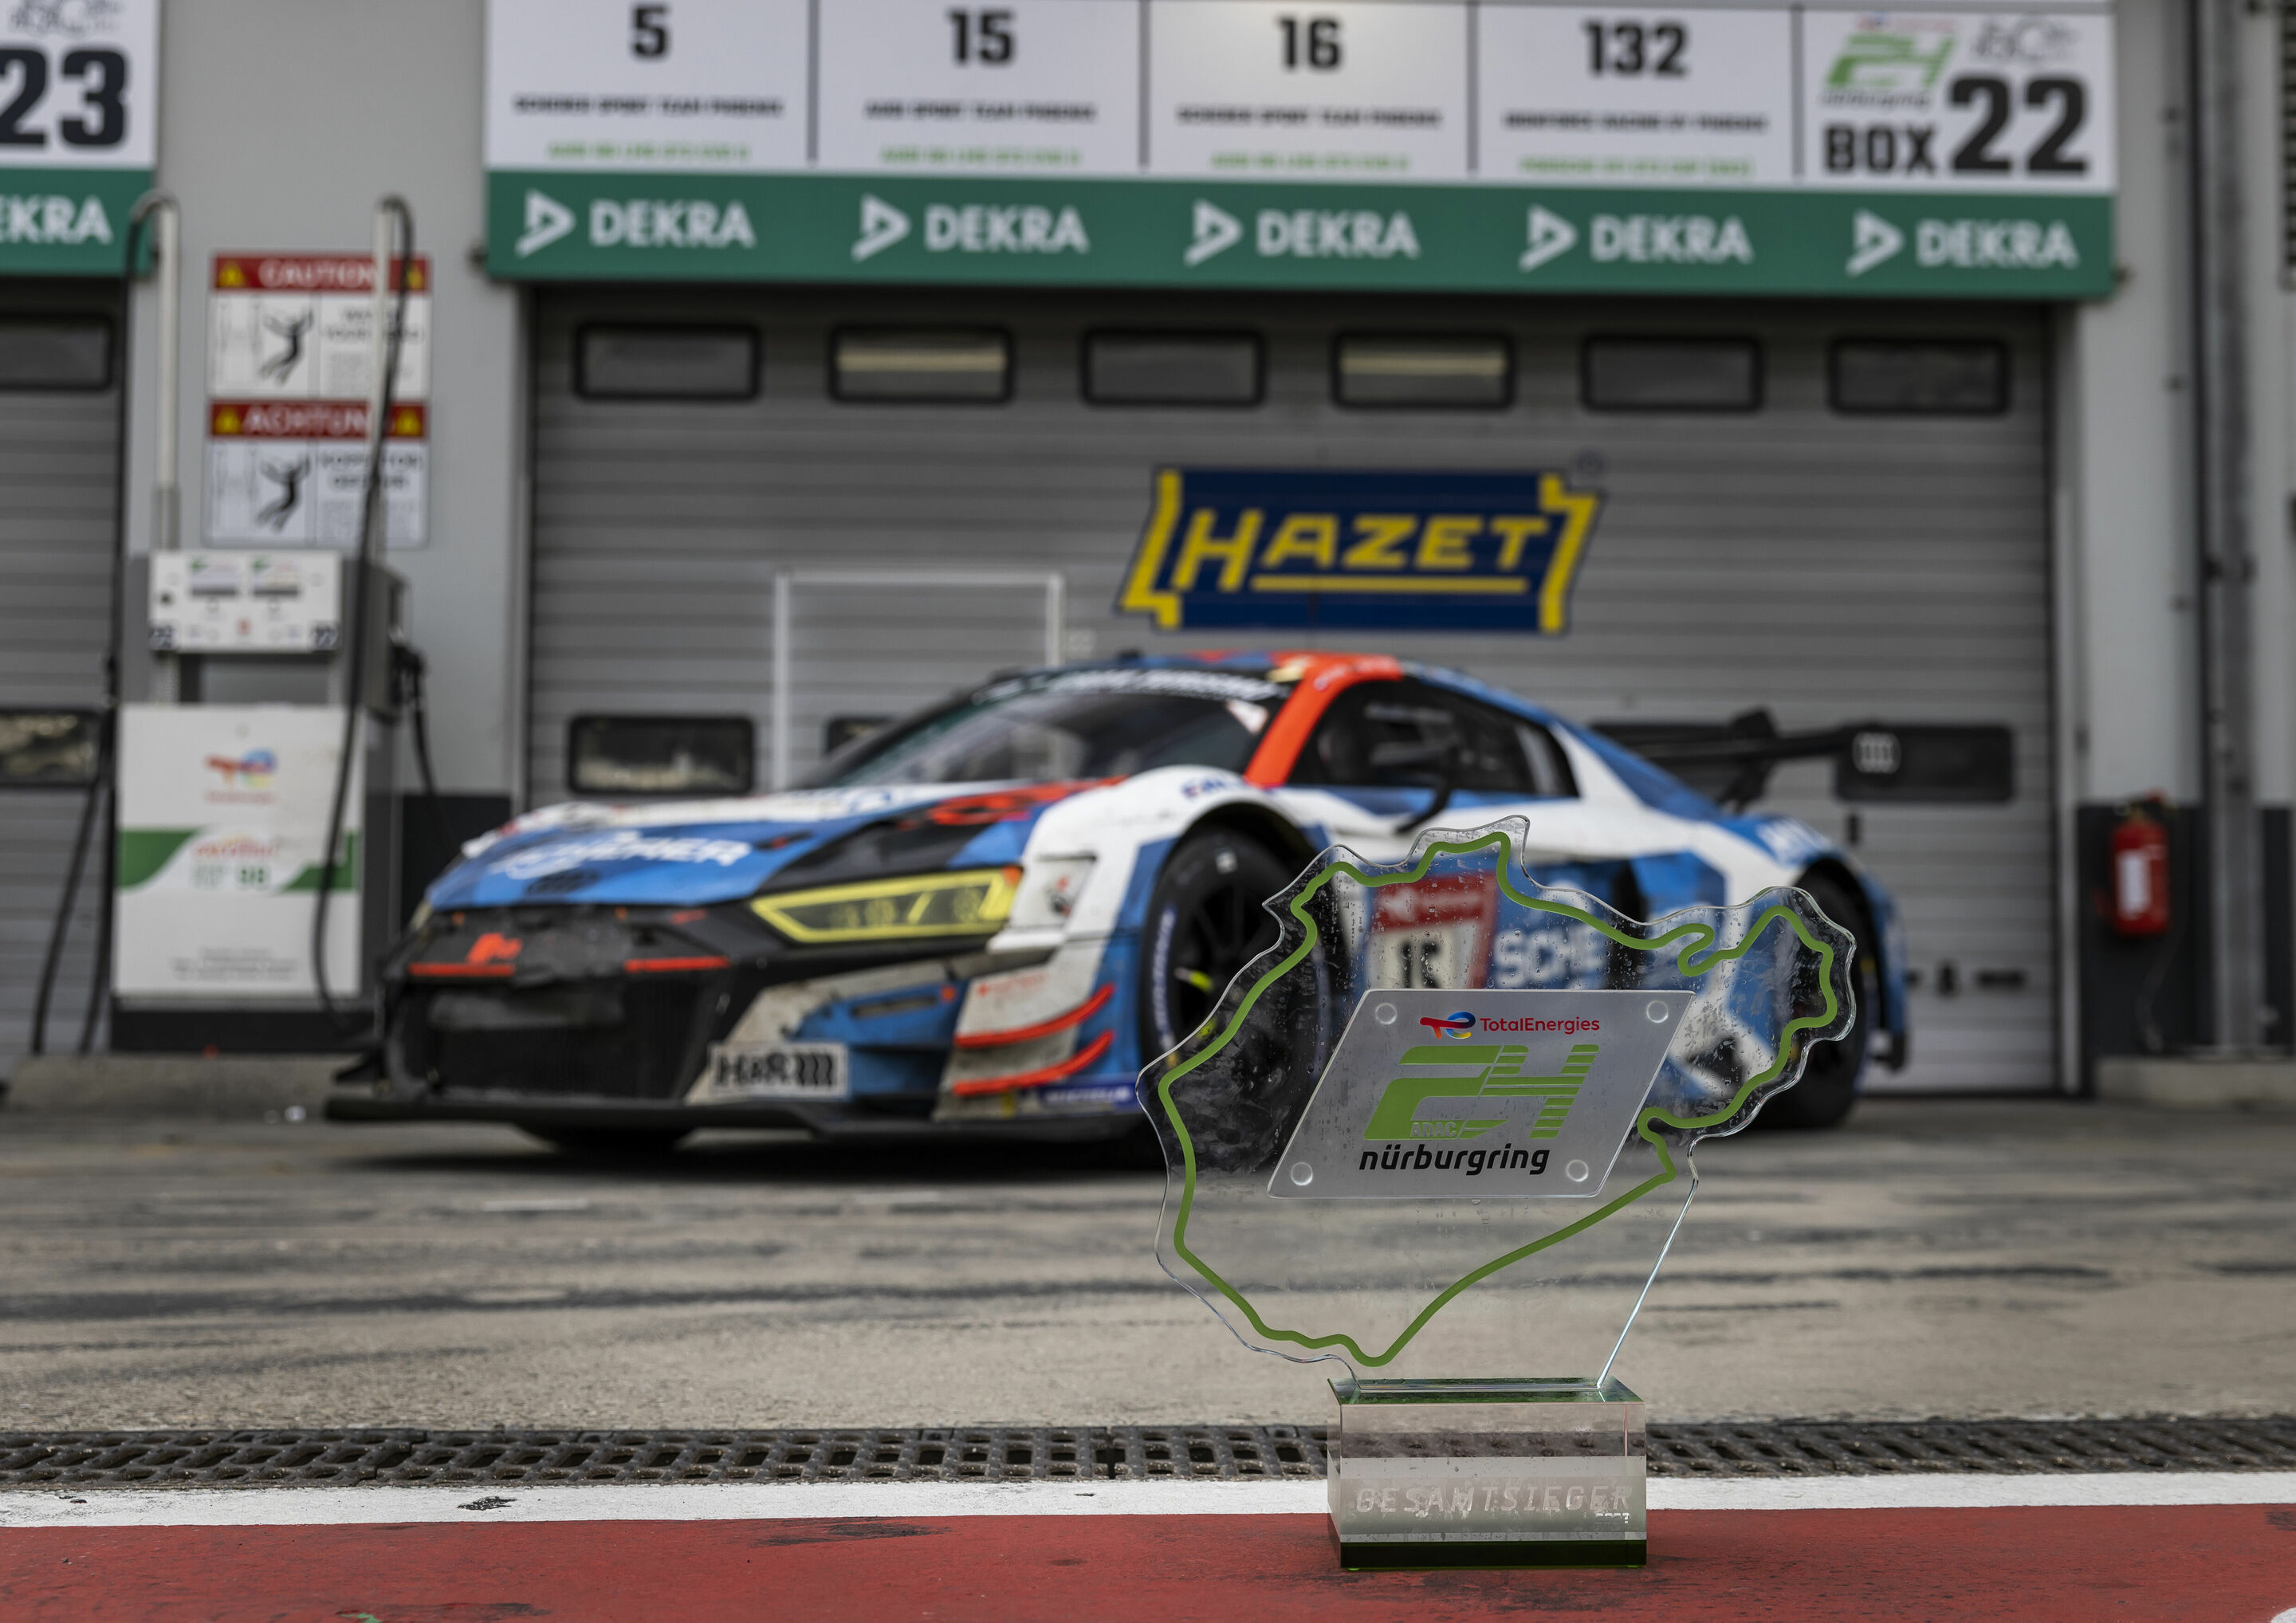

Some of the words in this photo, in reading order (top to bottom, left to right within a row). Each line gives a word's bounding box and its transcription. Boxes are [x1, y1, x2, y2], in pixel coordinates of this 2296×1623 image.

[631, 3, 670, 60] 5
[948, 9, 1016, 65] 15
[1279, 16, 1343, 71] 16
[1582, 20, 1689, 78] 132
[0, 45, 129, 149] 23
[1823, 124, 1937, 175] BOX
[1946, 73, 2090, 177] 22
[588, 200, 756, 249] DEKRA
[924, 205, 1090, 253] DEKRA
[1256, 210, 1421, 257] DEKRA
[1590, 215, 1753, 263] DEKRA
[1916, 220, 2078, 267] DEKRA
[1171, 508, 1550, 593] HAZET
[1480, 1016, 1600, 1035] TotalEnergies
[1409, 1122, 1458, 1138] ADAC
[1359, 1143, 1551, 1176] nürburgring
[1356, 1484, 1631, 1513] GESAMTSIEGER
